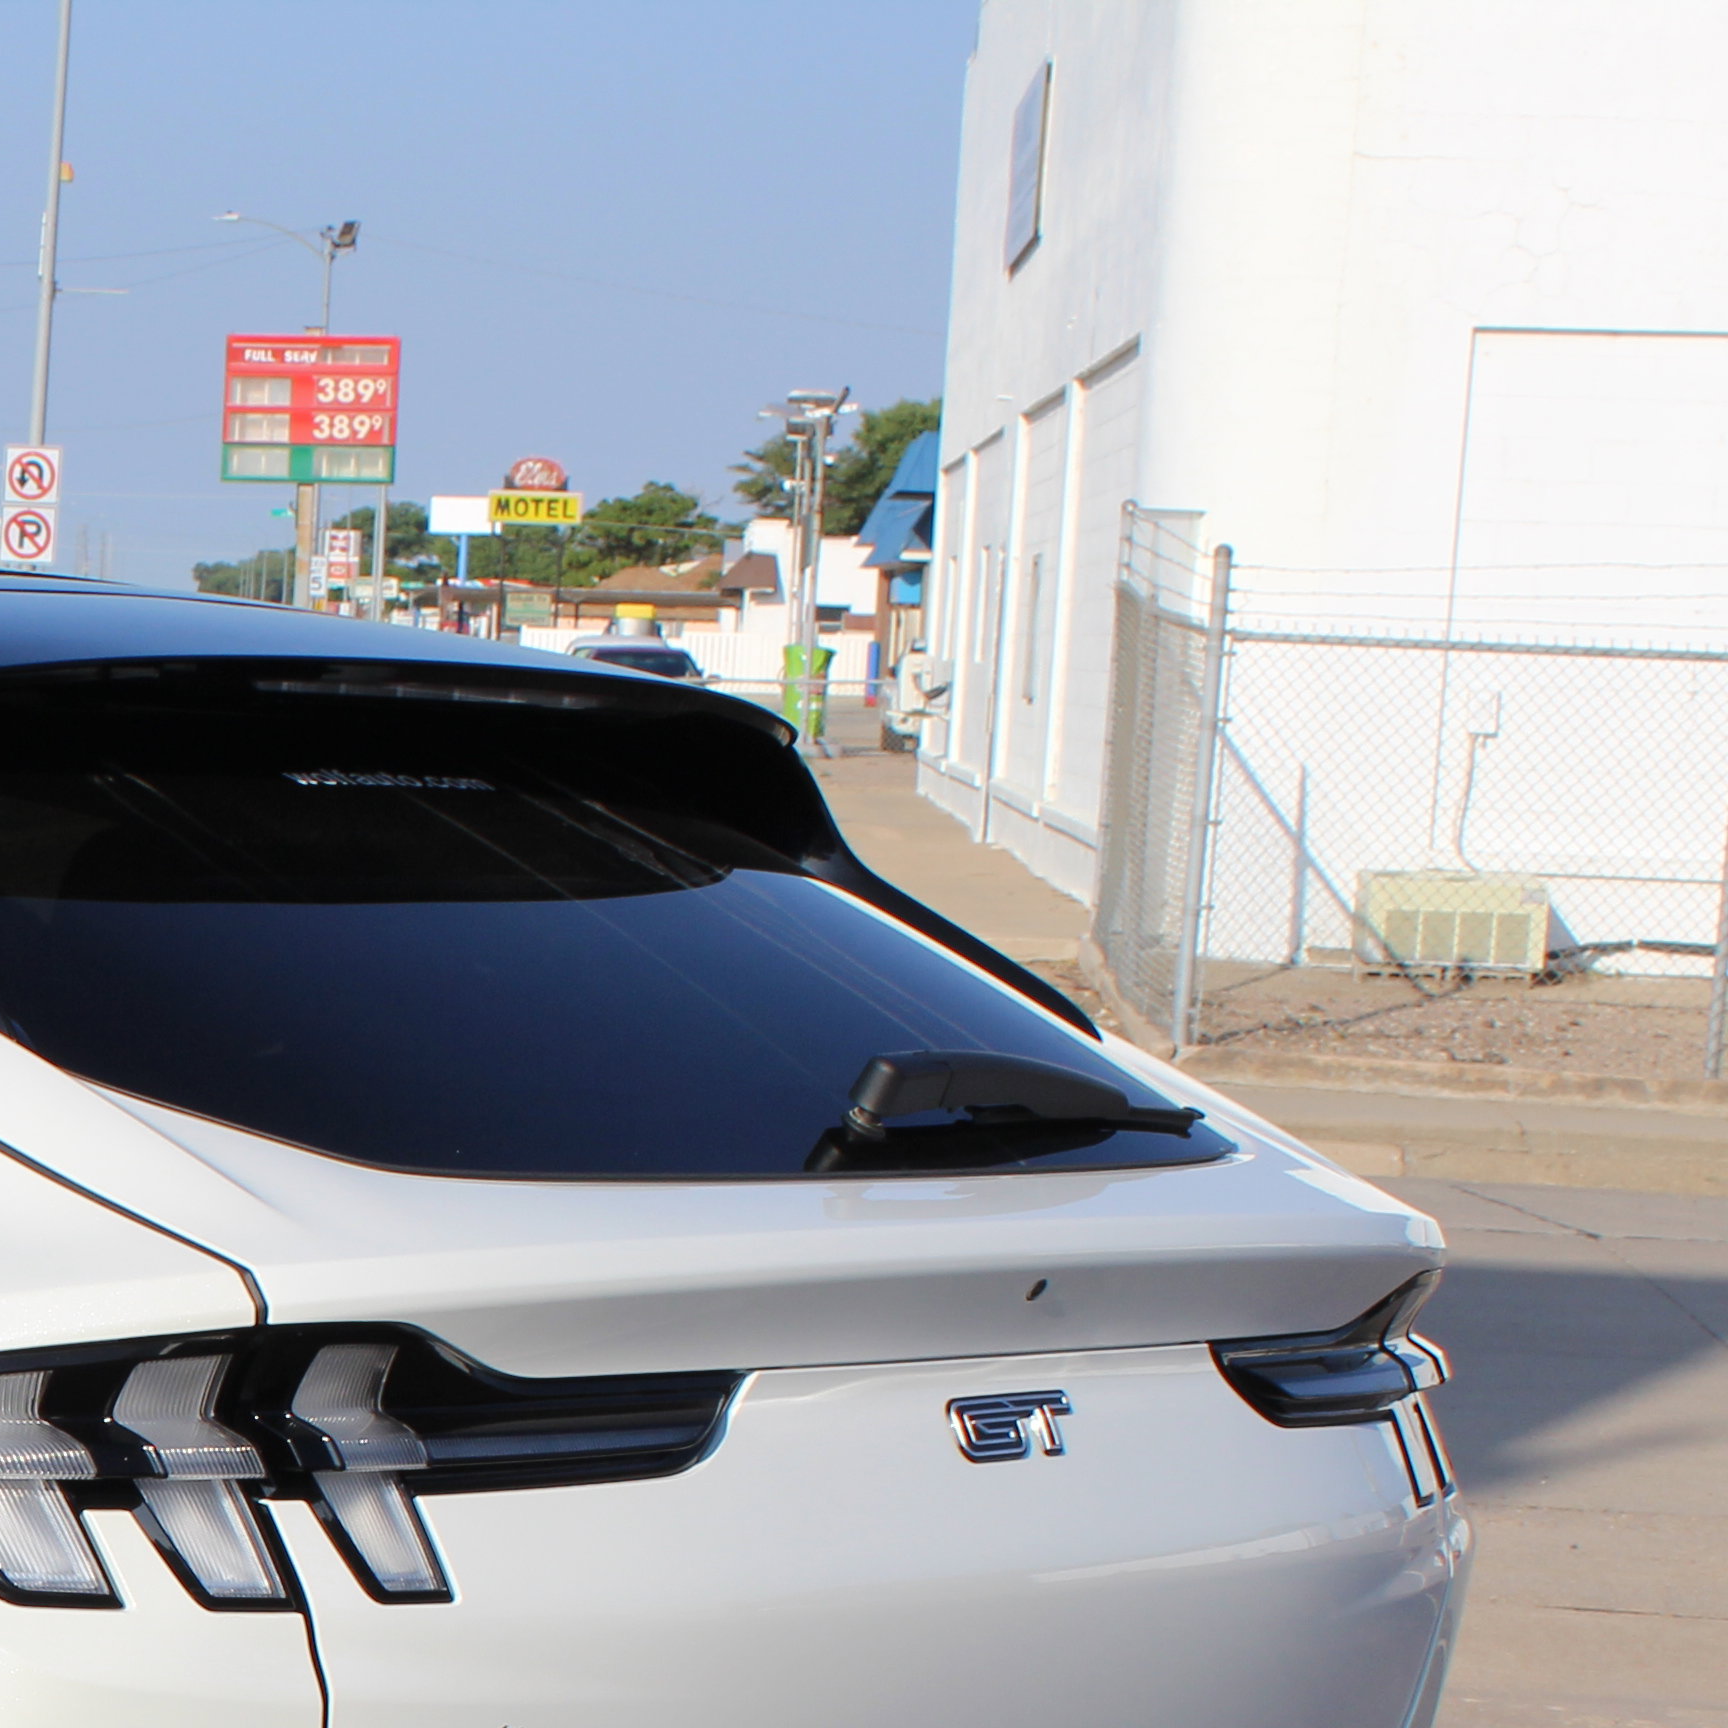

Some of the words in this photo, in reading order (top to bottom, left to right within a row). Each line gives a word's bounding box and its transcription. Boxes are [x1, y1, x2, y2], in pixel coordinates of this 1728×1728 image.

[244, 349, 275, 362] FULL
[495, 498, 575, 519] MOTEL
[945, 1389, 1072, 1463] GT
